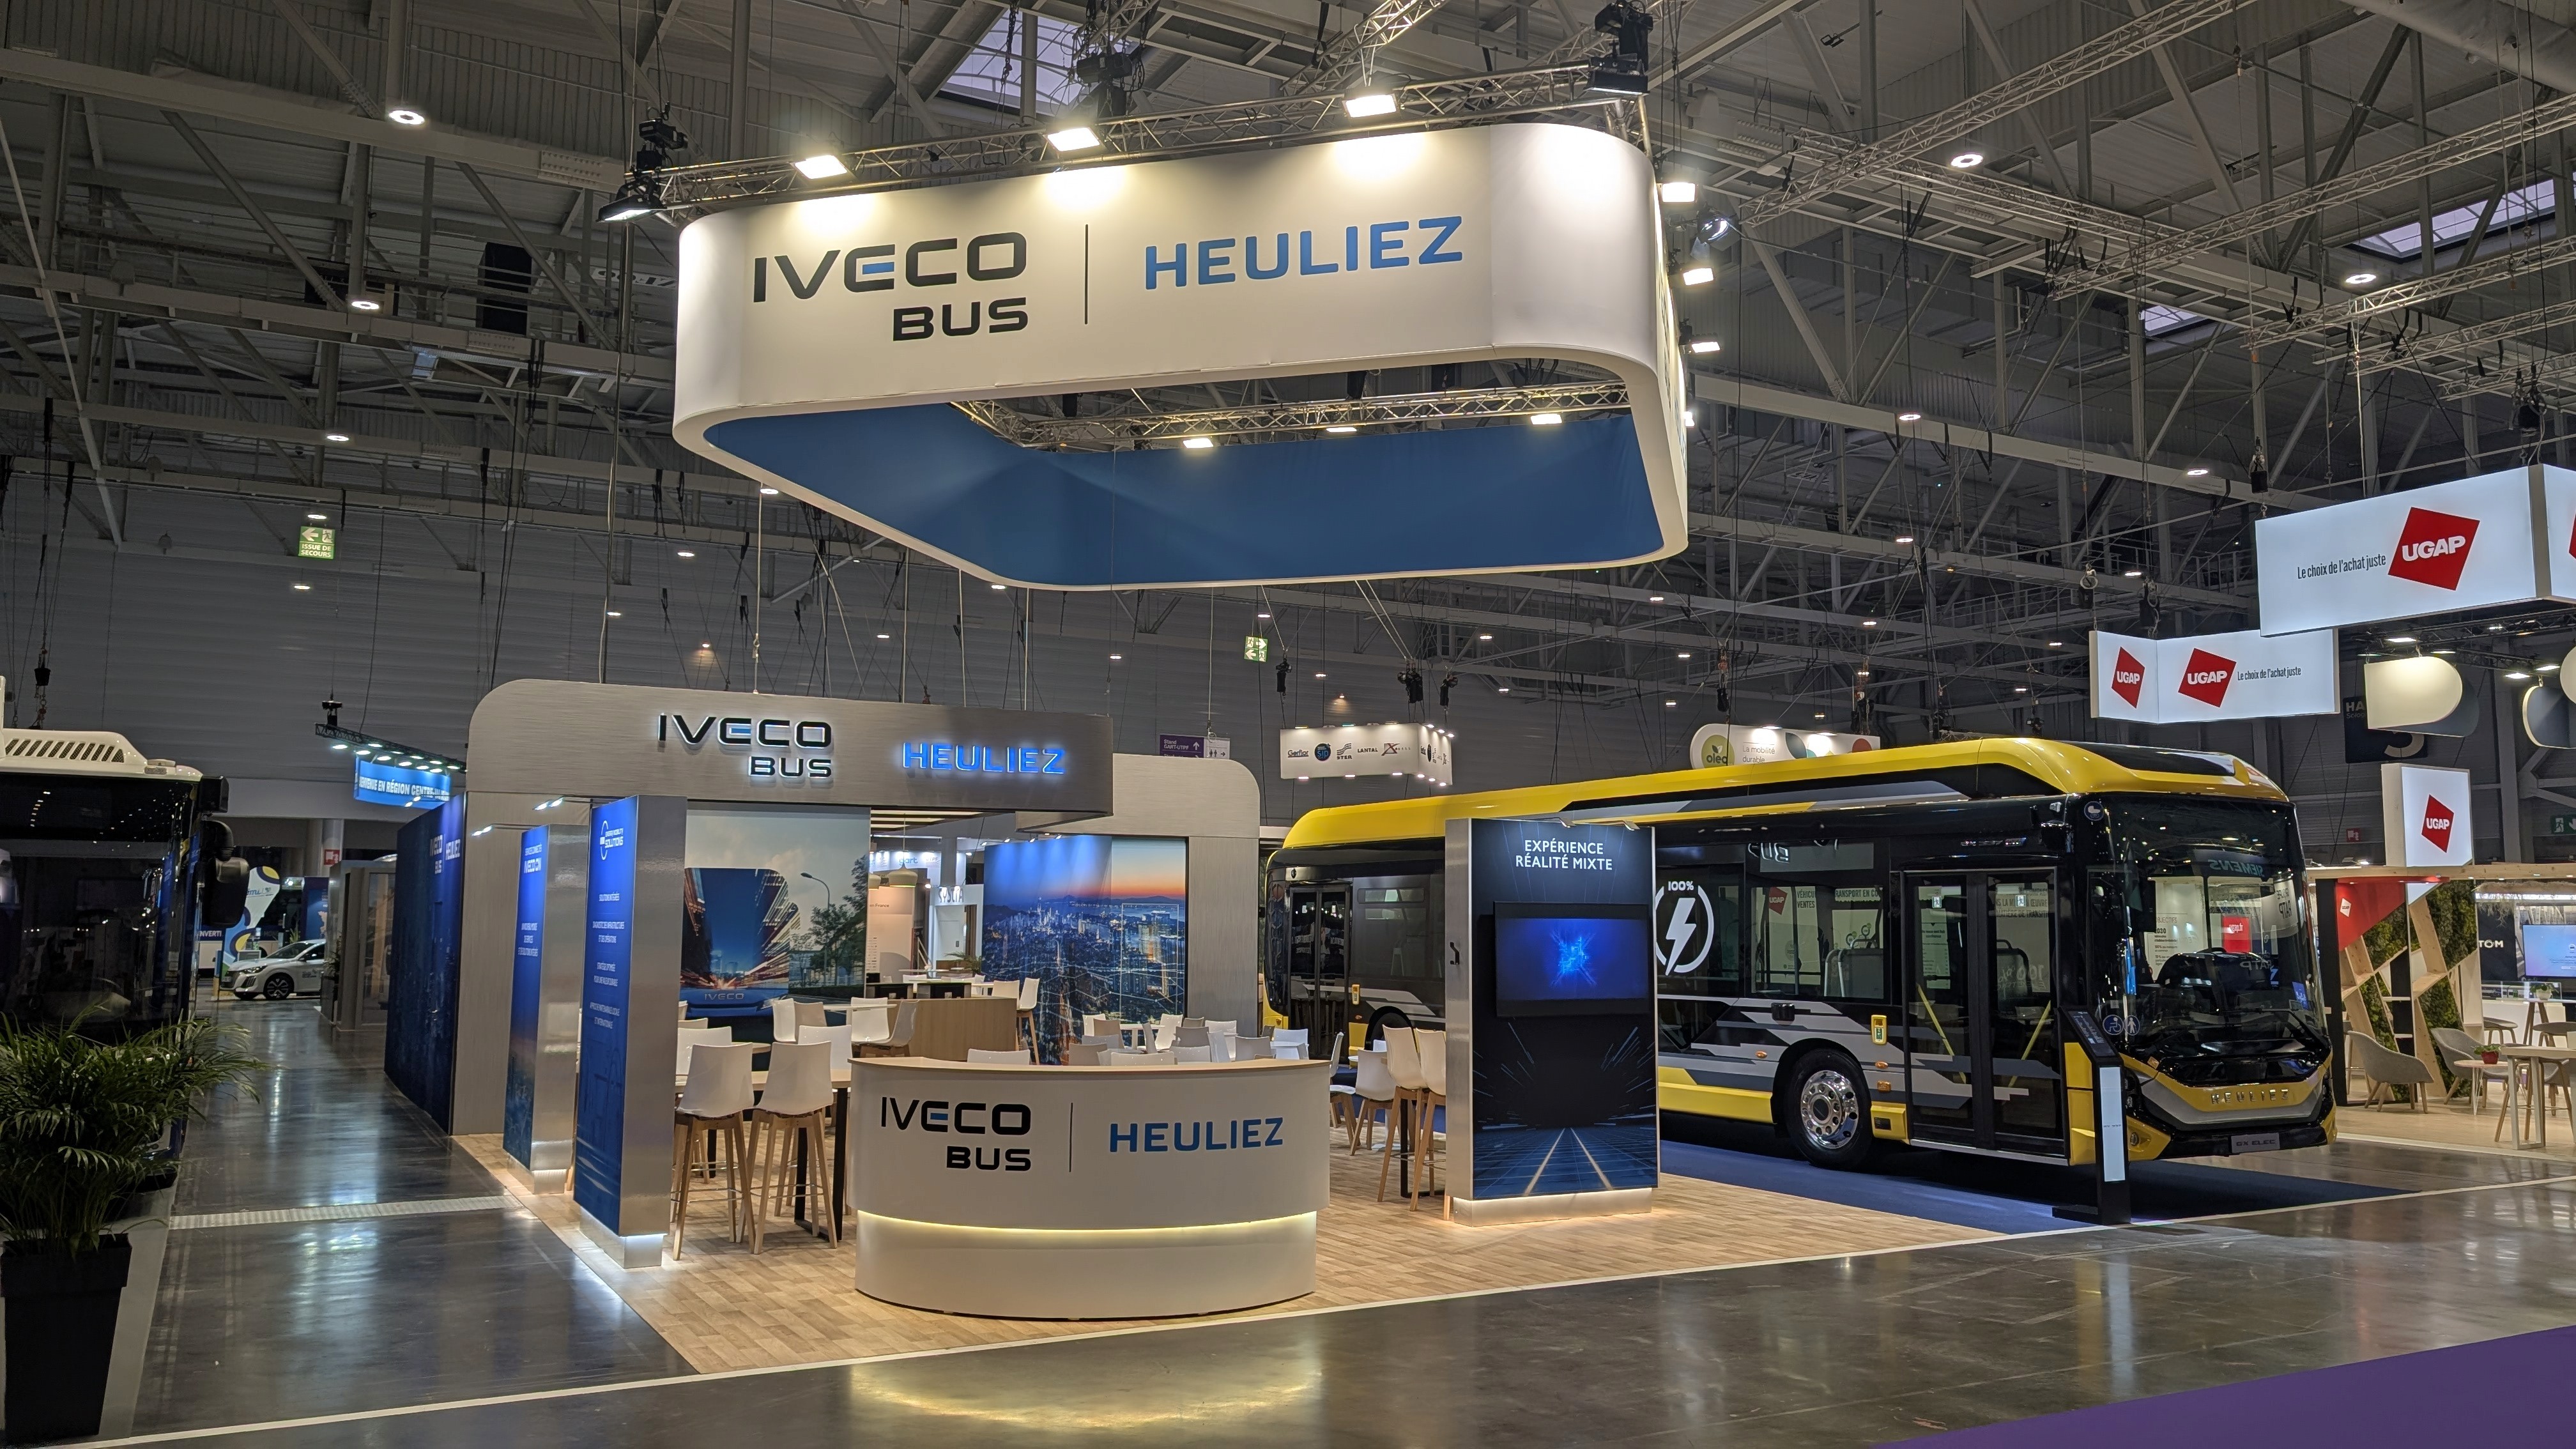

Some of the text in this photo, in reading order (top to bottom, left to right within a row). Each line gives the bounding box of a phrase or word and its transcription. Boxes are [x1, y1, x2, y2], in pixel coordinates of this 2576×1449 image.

[753, 215, 1463, 303] IVECO HEULIEZ
[893, 297, 1028, 341] BUS
[301, 549, 332, 558] SECOURS
[2402, 535, 2465, 562] UGAP
[2297, 553, 2386, 579] Le choix de l'achat juste
[2117, 671, 2140, 685] UGAP
[2188, 671, 2228, 685] UGAP
[2237, 666, 2301, 681] Le choix de l'achat juste
[659, 713, 1066, 774] IVECO HEULIEZ
[749, 756, 832, 778] BUS
[378, 781, 385, 792] EN
[387, 779, 410, 795] RÉGION
[2426, 818, 2450, 830] UGAP
[1524, 838, 1604, 855] EXPÉRIENCE
[1515, 854, 1613, 871] RÉALITÉ MIXTE
[1667, 880, 1694, 892] 100%
[1797, 889, 1816, 898] VÉHICU
[2211, 1088, 2290, 1105] HEULIEZ
[881, 1096, 1284, 1153] IVECO HEULIEZ
[946, 1146, 1031, 1172] BUS
